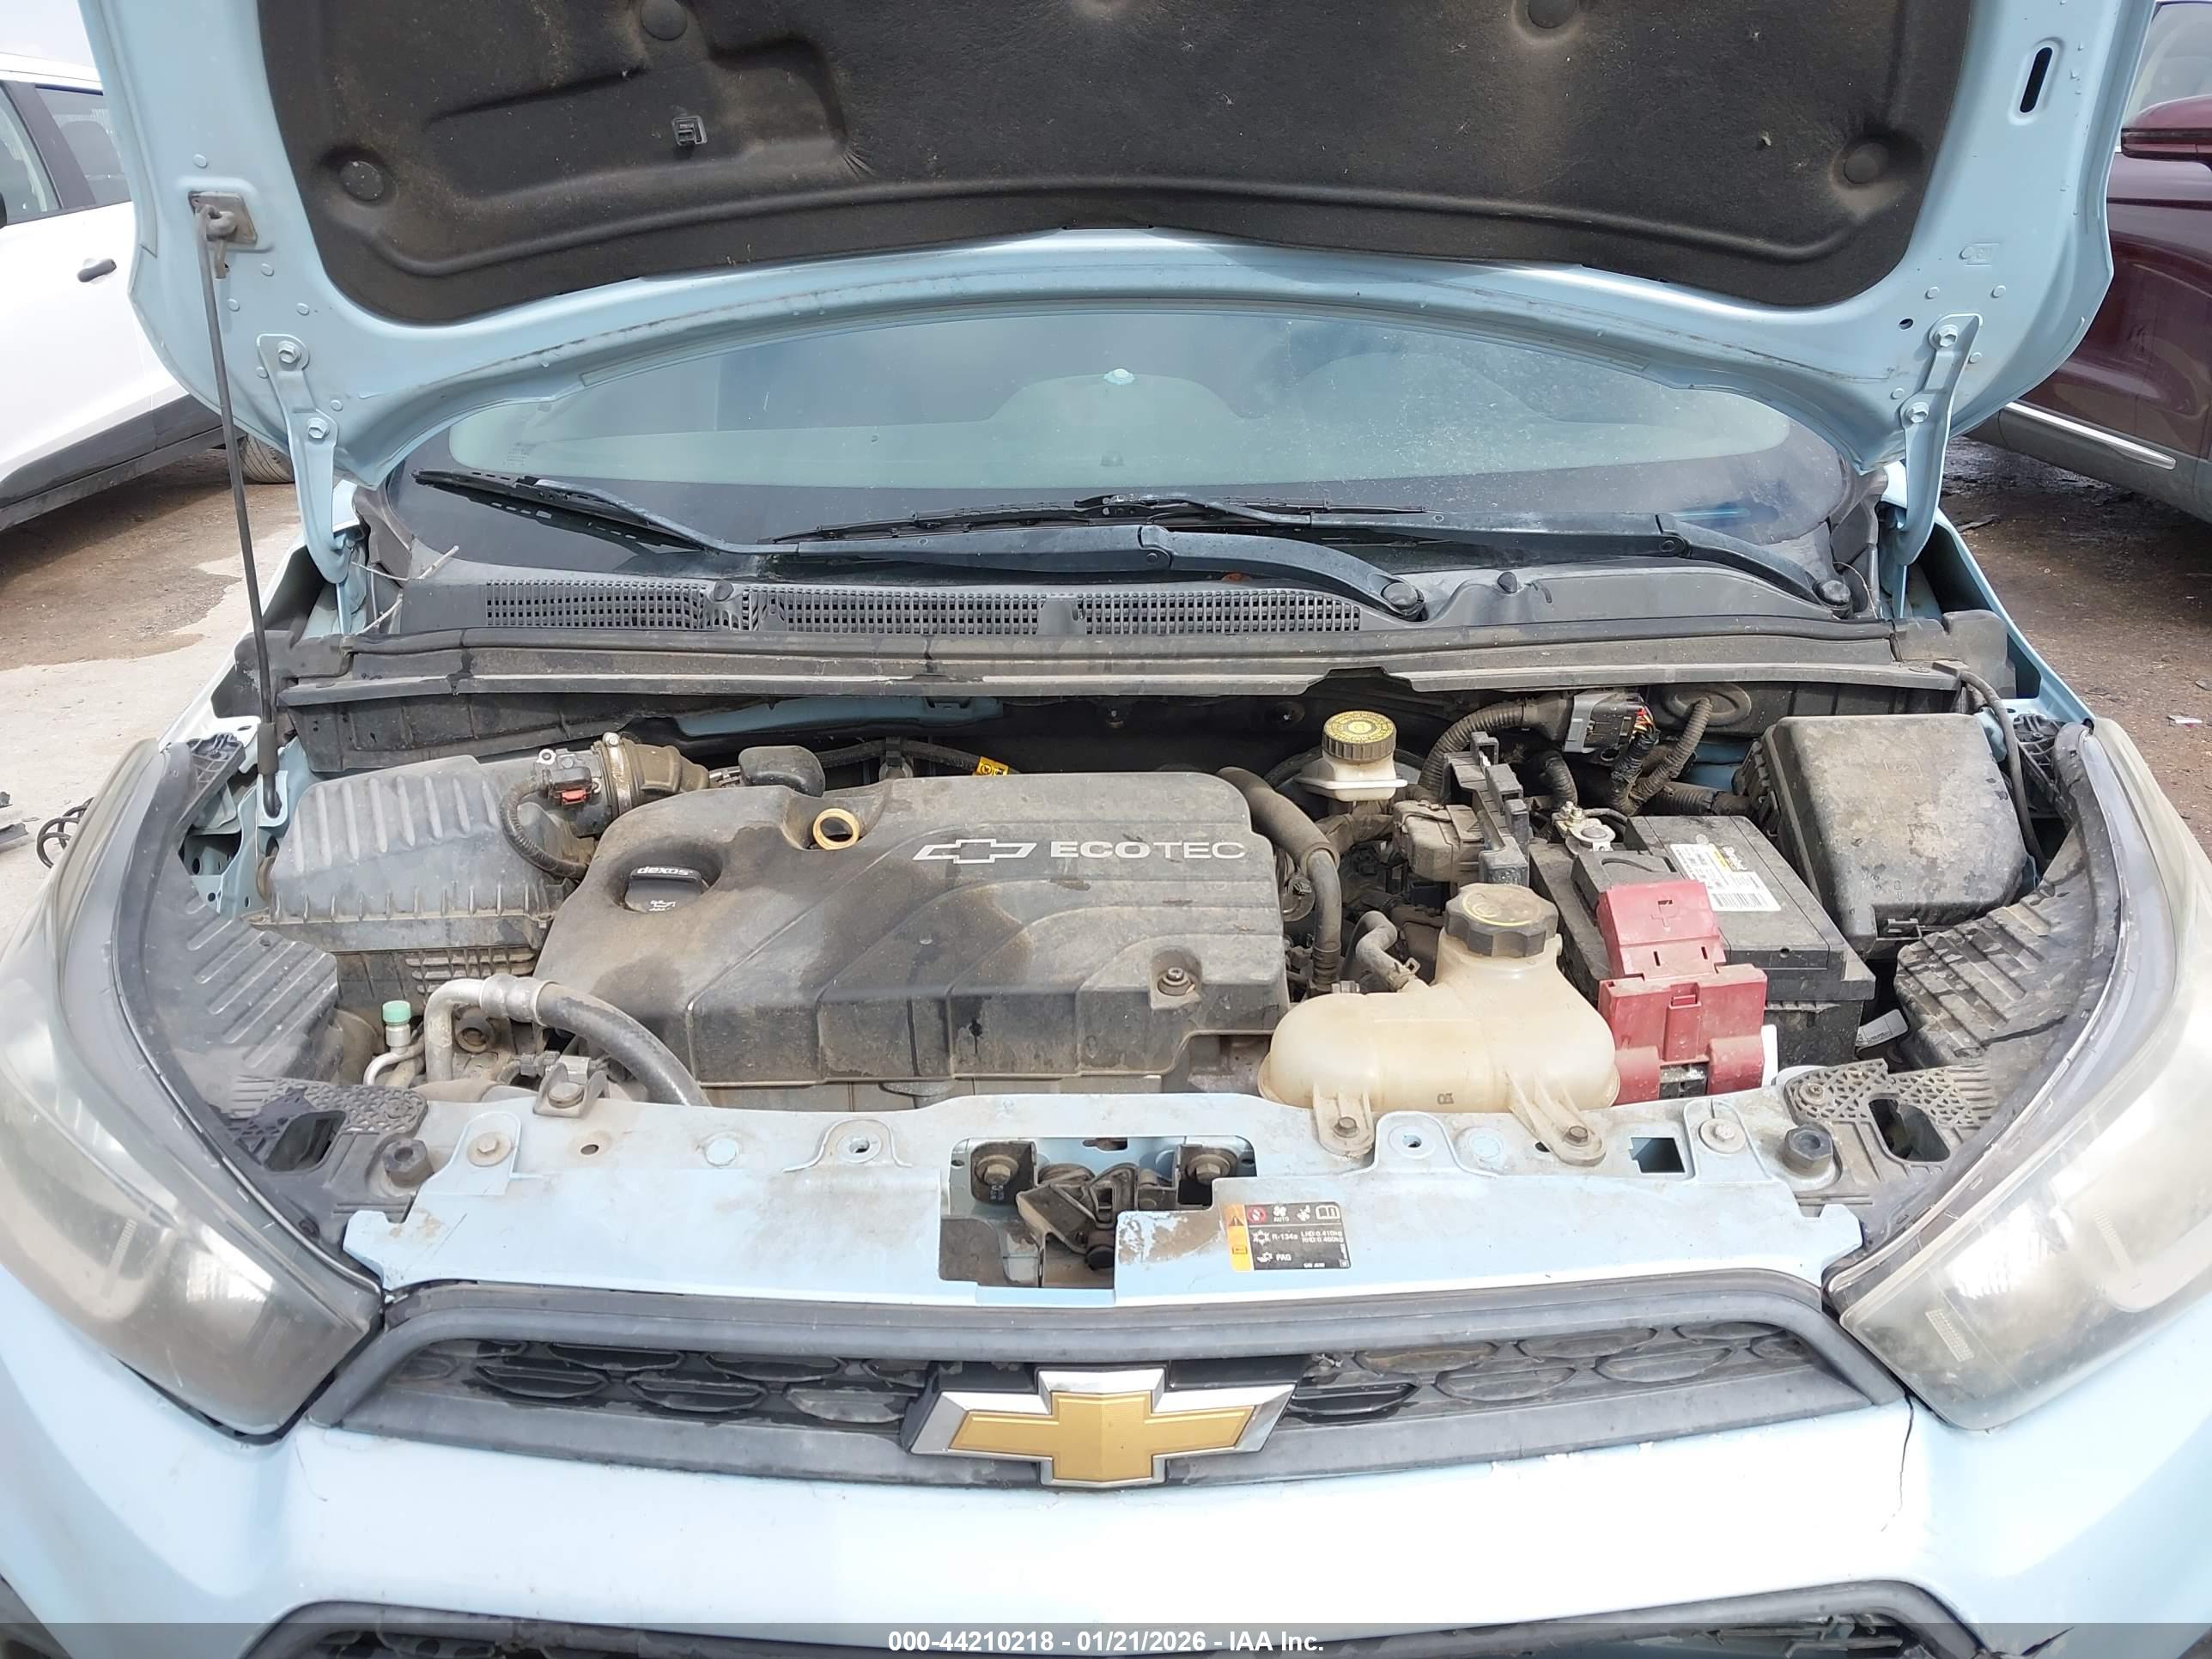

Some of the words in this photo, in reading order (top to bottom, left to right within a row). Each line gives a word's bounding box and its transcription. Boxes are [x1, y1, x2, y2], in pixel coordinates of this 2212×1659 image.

[1049, 840, 1245, 860] ECOTEC
[1272, 1232, 1298, 1241] R-134a
[1275, 1253, 1292, 1261] PAG
